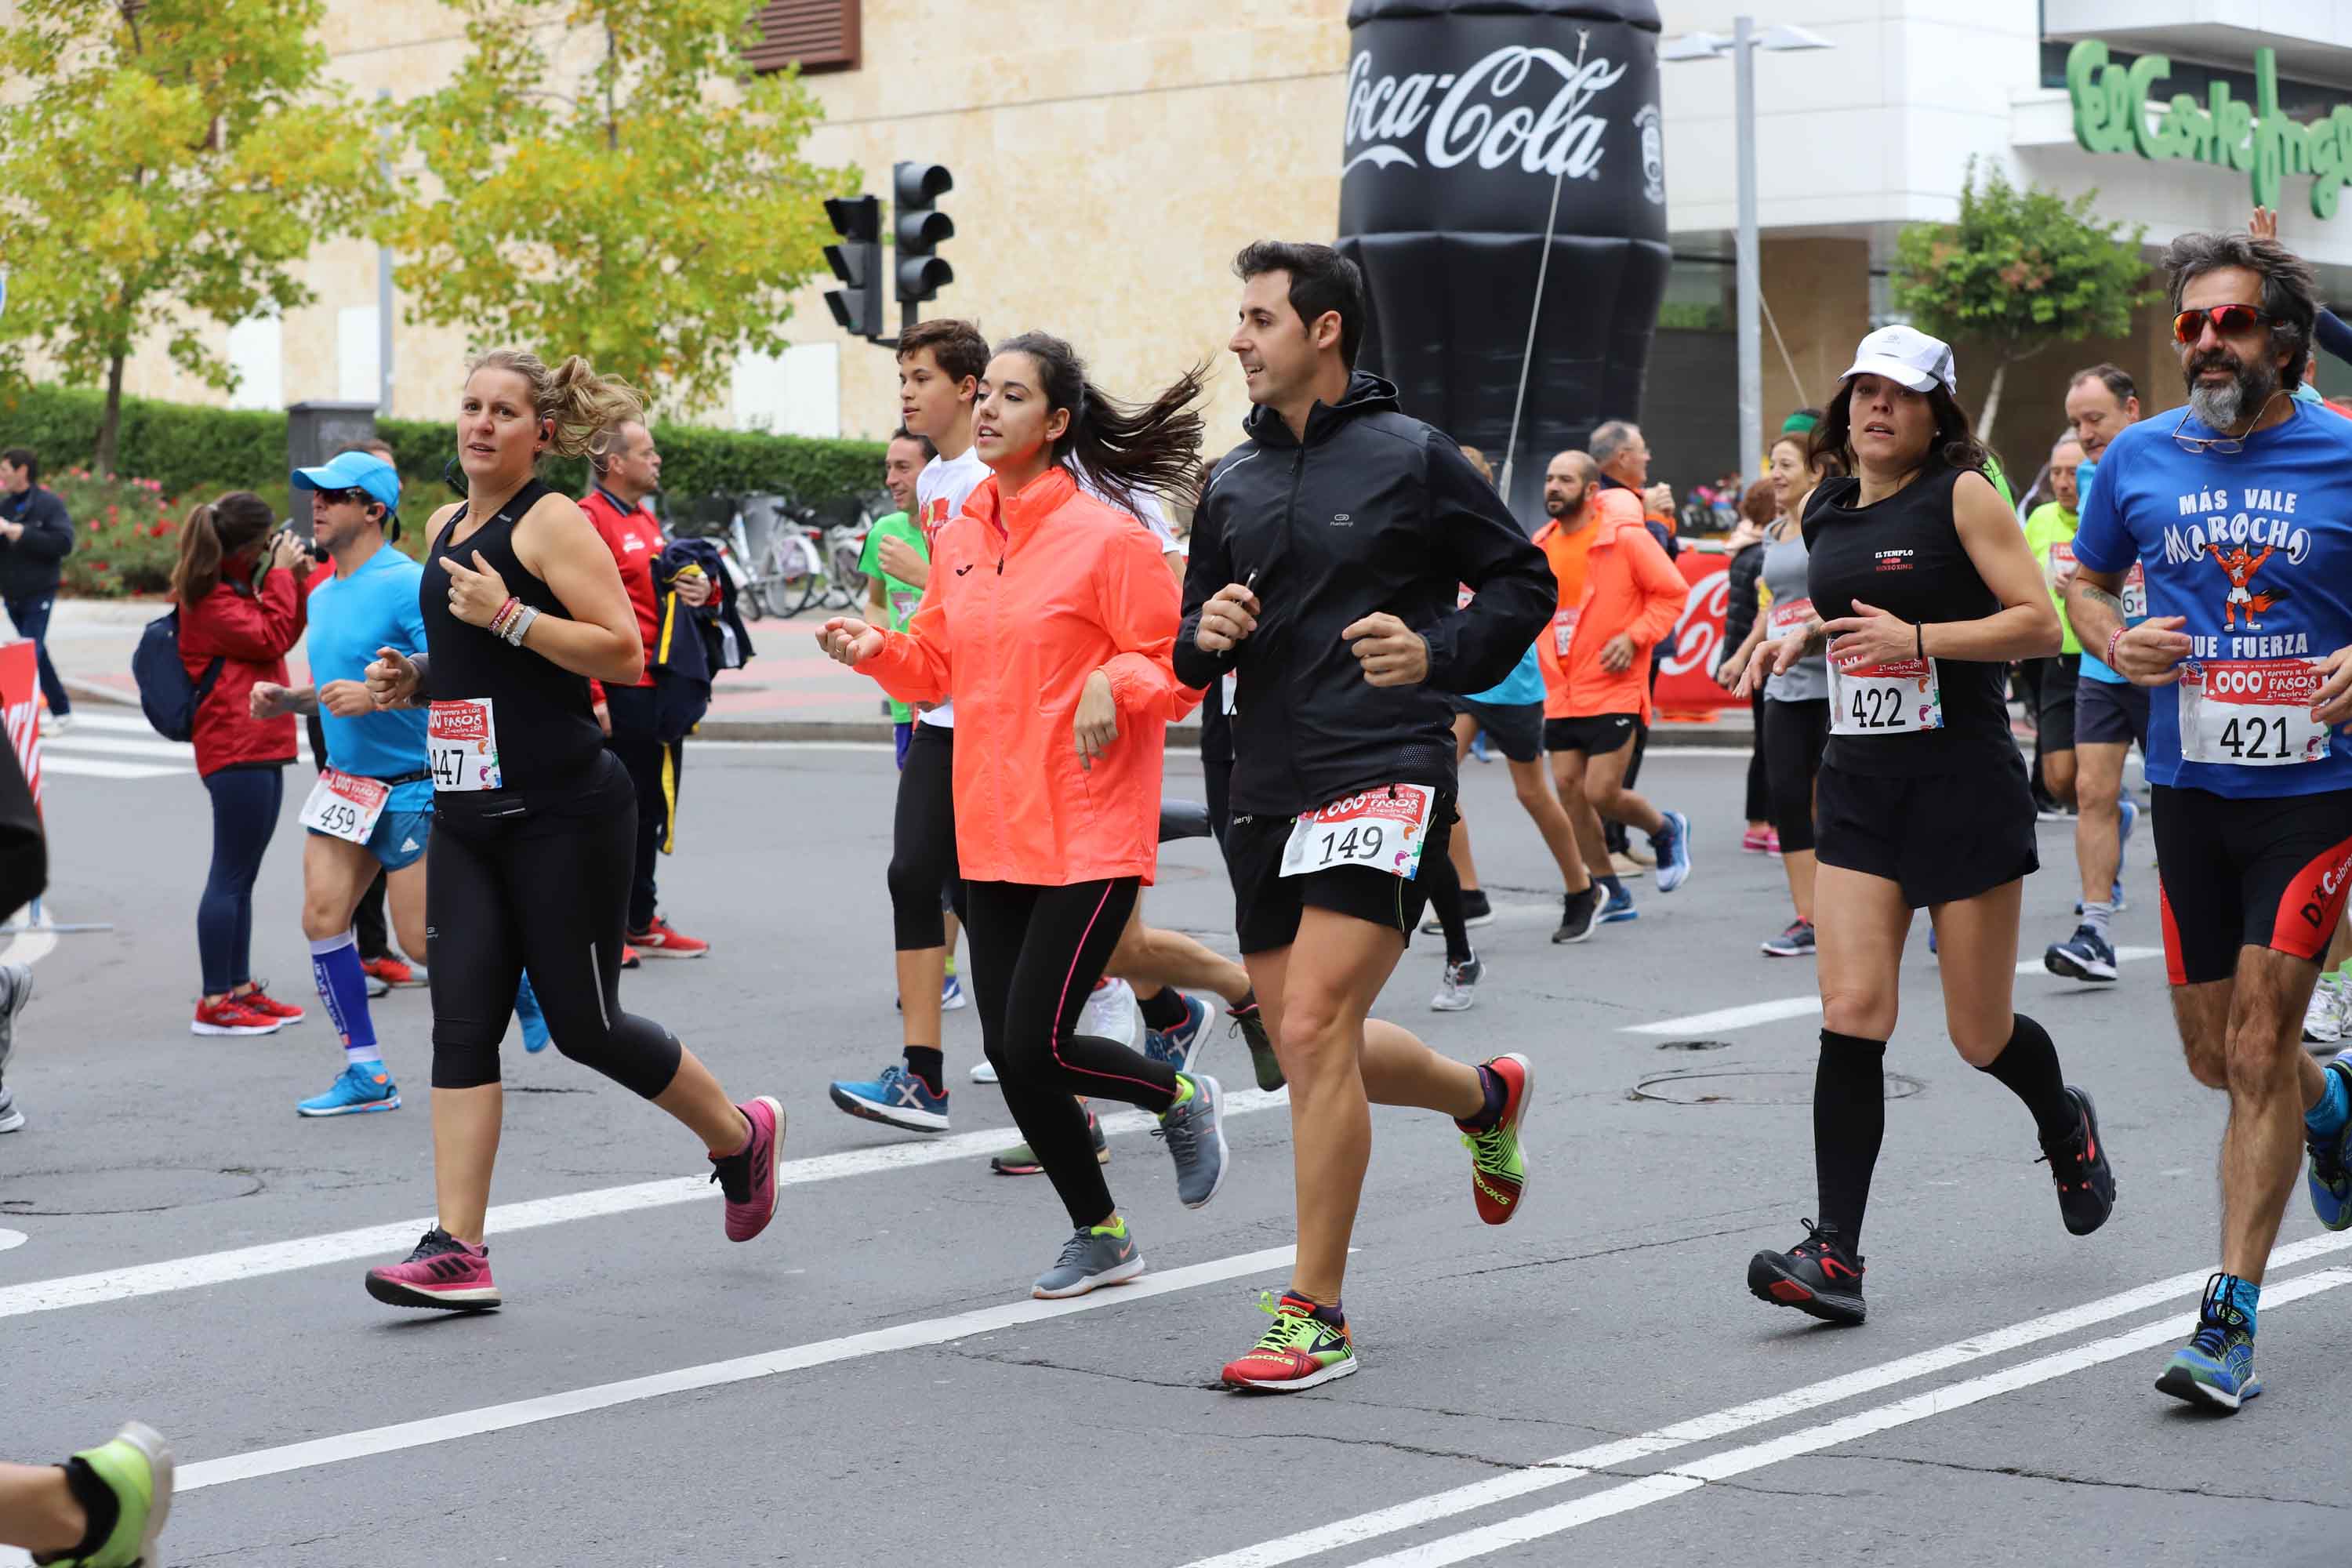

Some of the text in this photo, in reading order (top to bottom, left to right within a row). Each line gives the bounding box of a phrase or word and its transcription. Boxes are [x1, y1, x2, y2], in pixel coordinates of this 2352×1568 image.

[1345, 45, 1628, 179] Coca-Cola
[2179, 485, 2298, 516] MÁS VALE
[2164, 512, 2311, 565] MOROCHO
[2232, 633, 2309, 659] FUERZA
[2201, 670, 2317, 695] 1.000 PASOS
[444, 714, 482, 728] PASOS
[1852, 688, 1906, 728] 422
[2220, 717, 2292, 759] 421
[319, 804, 357, 834] 459
[1370, 799, 1420, 808] PASOS
[1319, 826, 1384, 866] 149
[2322, 853, 2352, 895] Cabre
